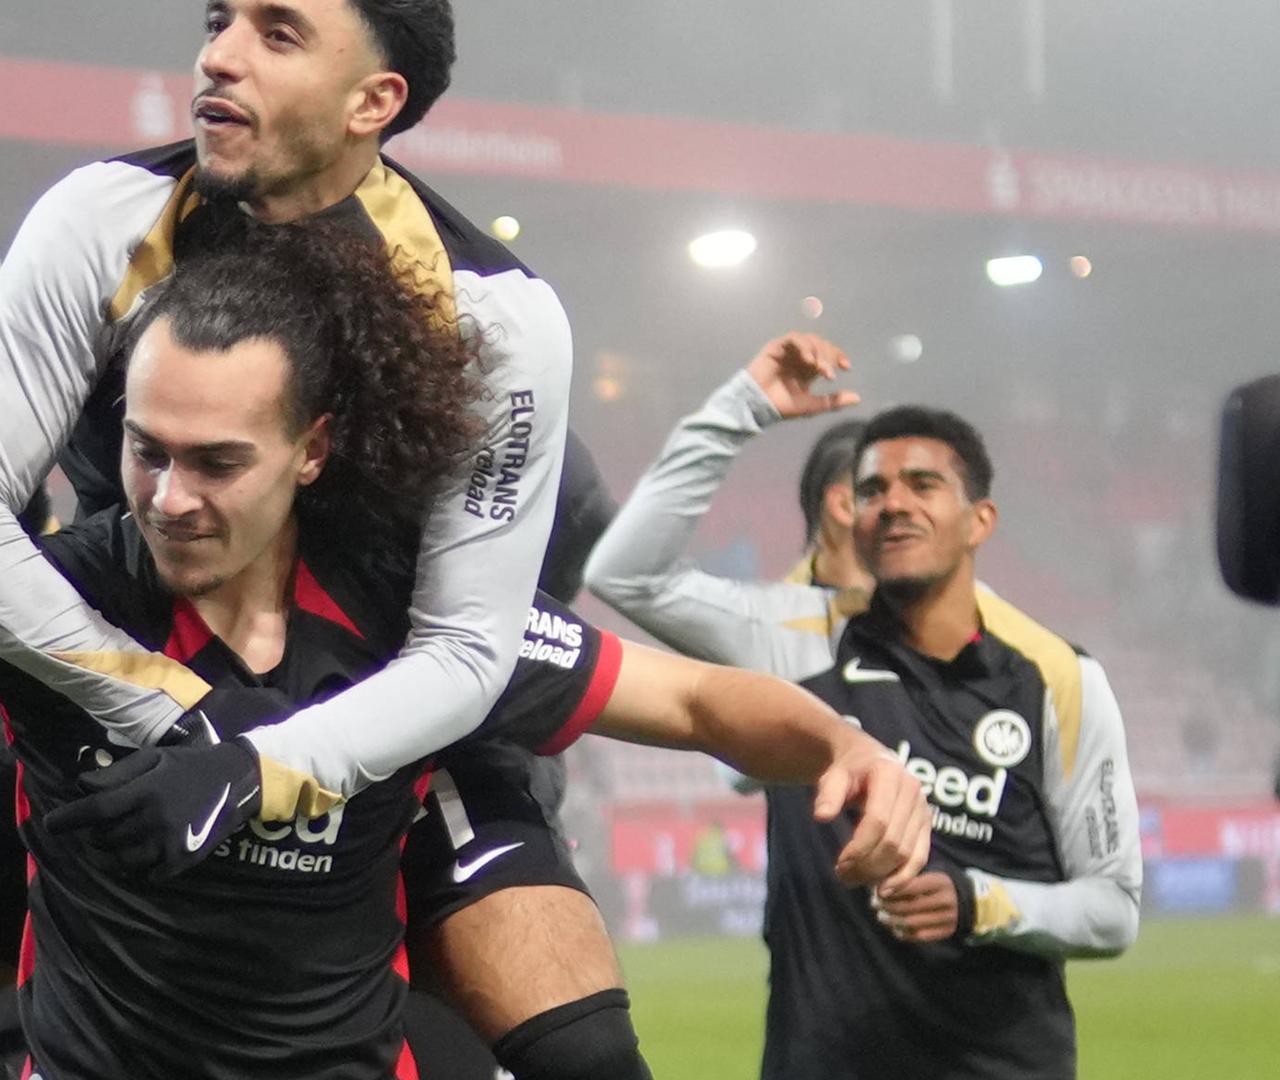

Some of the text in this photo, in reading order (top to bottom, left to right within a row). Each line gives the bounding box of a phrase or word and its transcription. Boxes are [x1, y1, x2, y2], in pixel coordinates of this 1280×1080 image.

[491, 389, 536, 523] ELOTRANS
[518, 636, 581, 671] eload
[240, 836, 335, 874] finden
